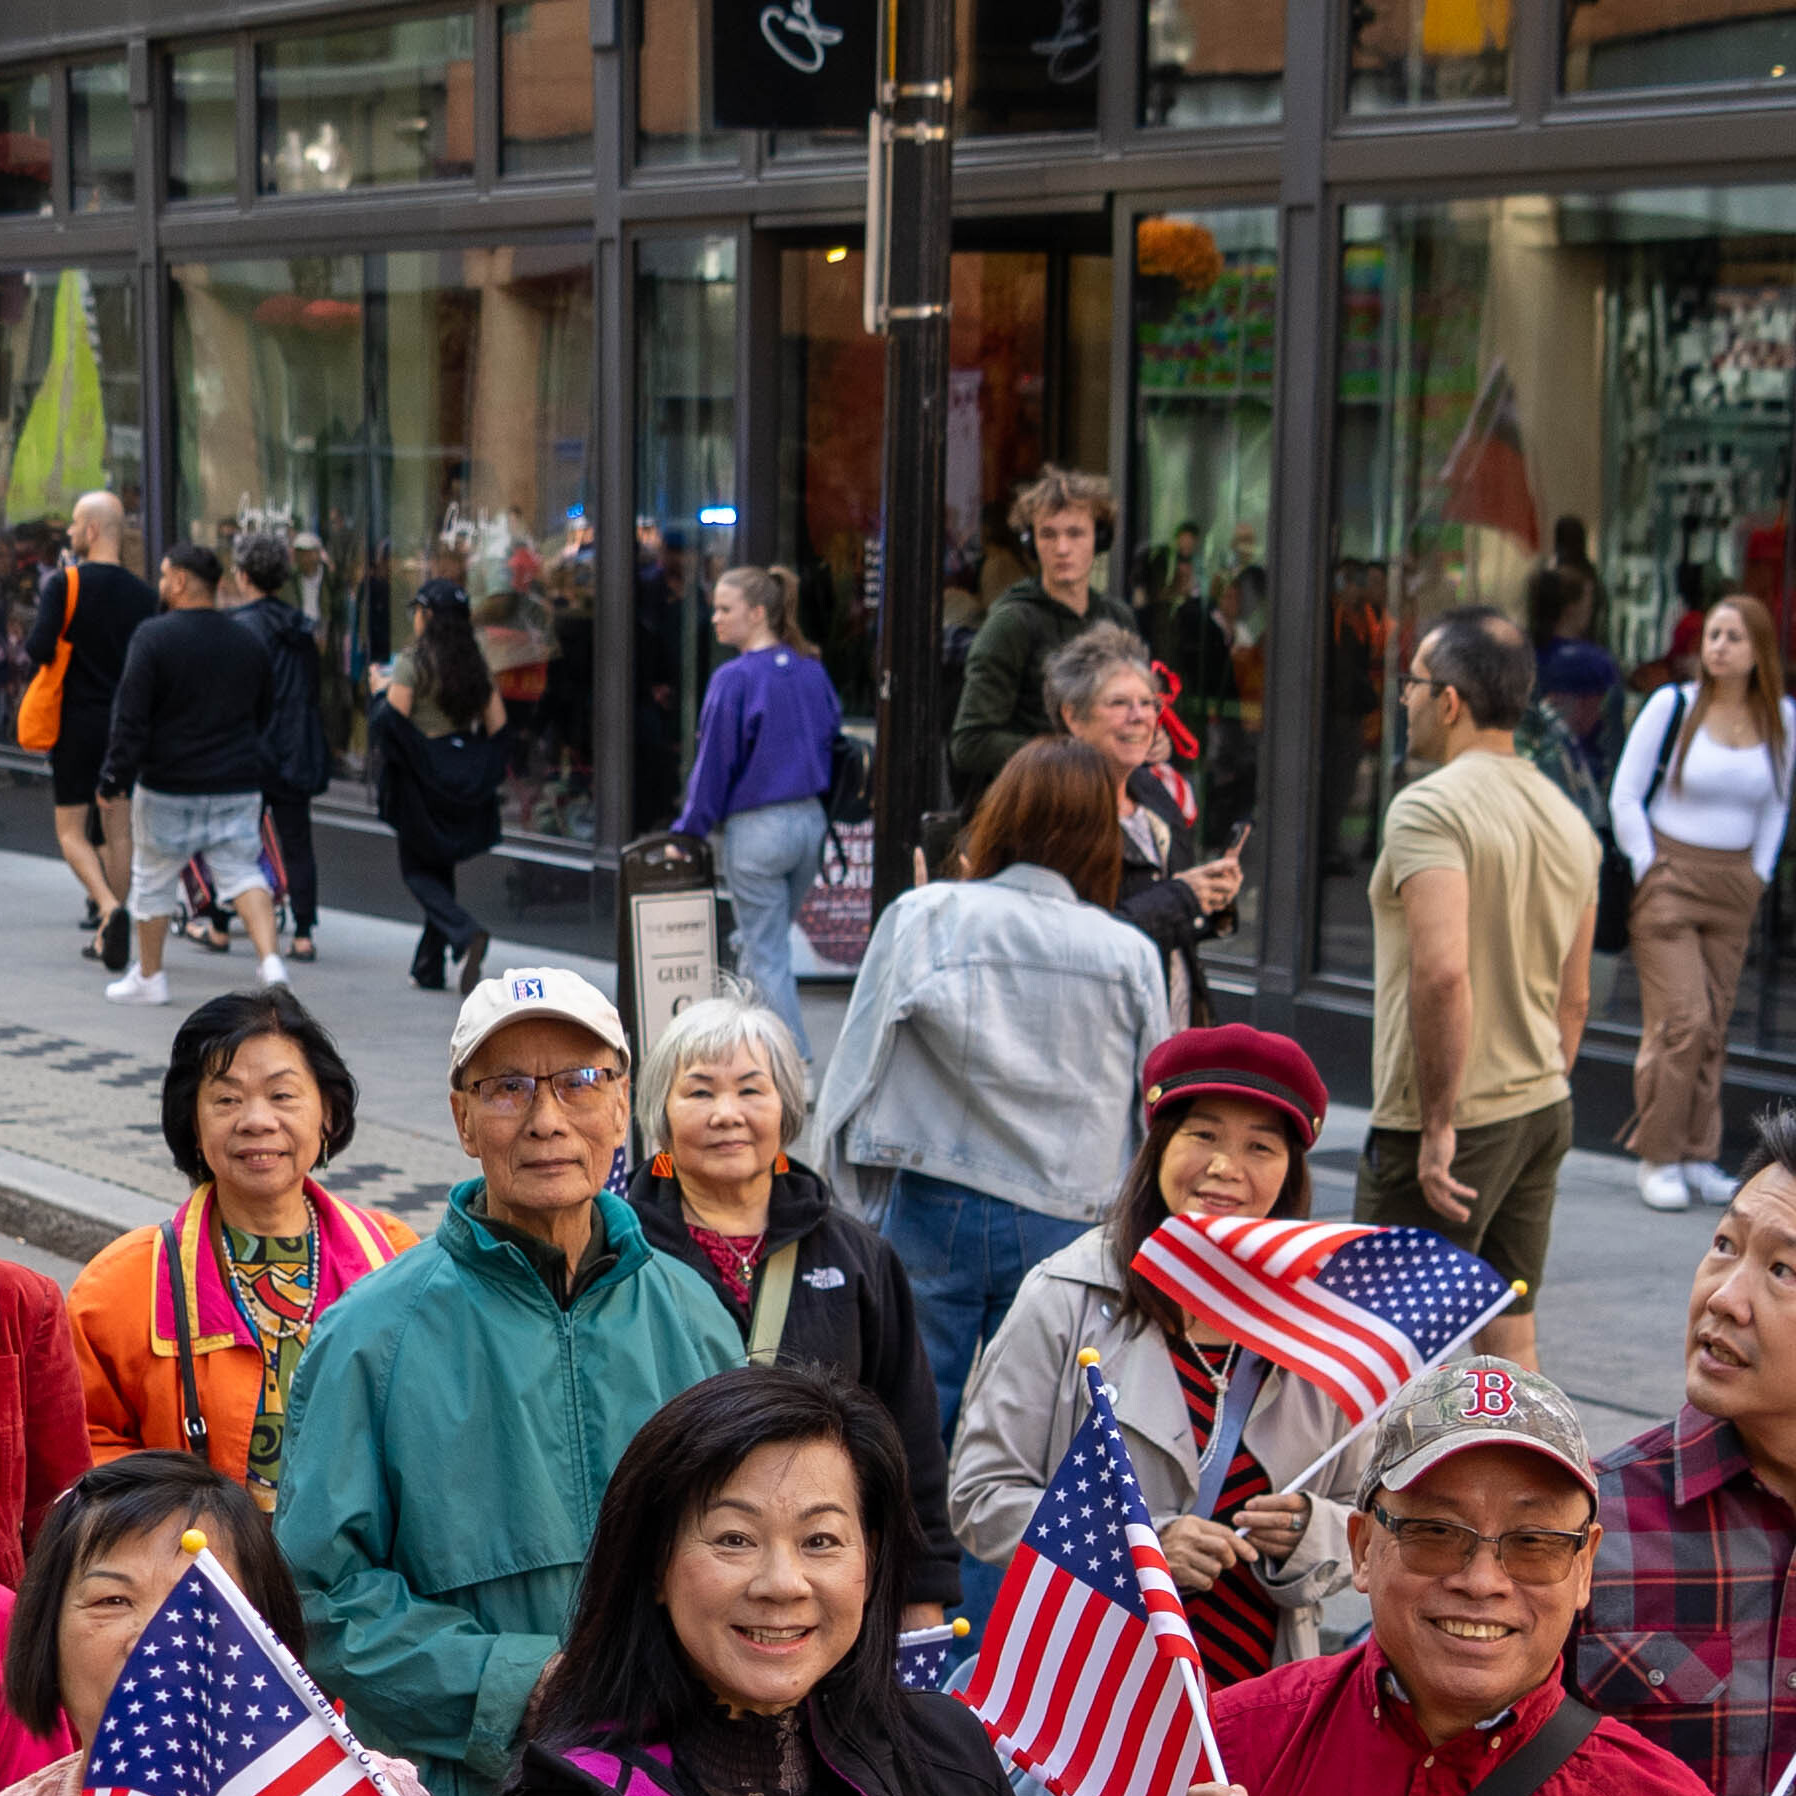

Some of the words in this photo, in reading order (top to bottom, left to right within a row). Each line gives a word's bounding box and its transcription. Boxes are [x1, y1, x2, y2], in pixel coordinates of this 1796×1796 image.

[657, 965, 700, 983] GUEST
[1460, 1368, 1517, 1419] B
[342, 1731, 387, 1793] R.O.C.
